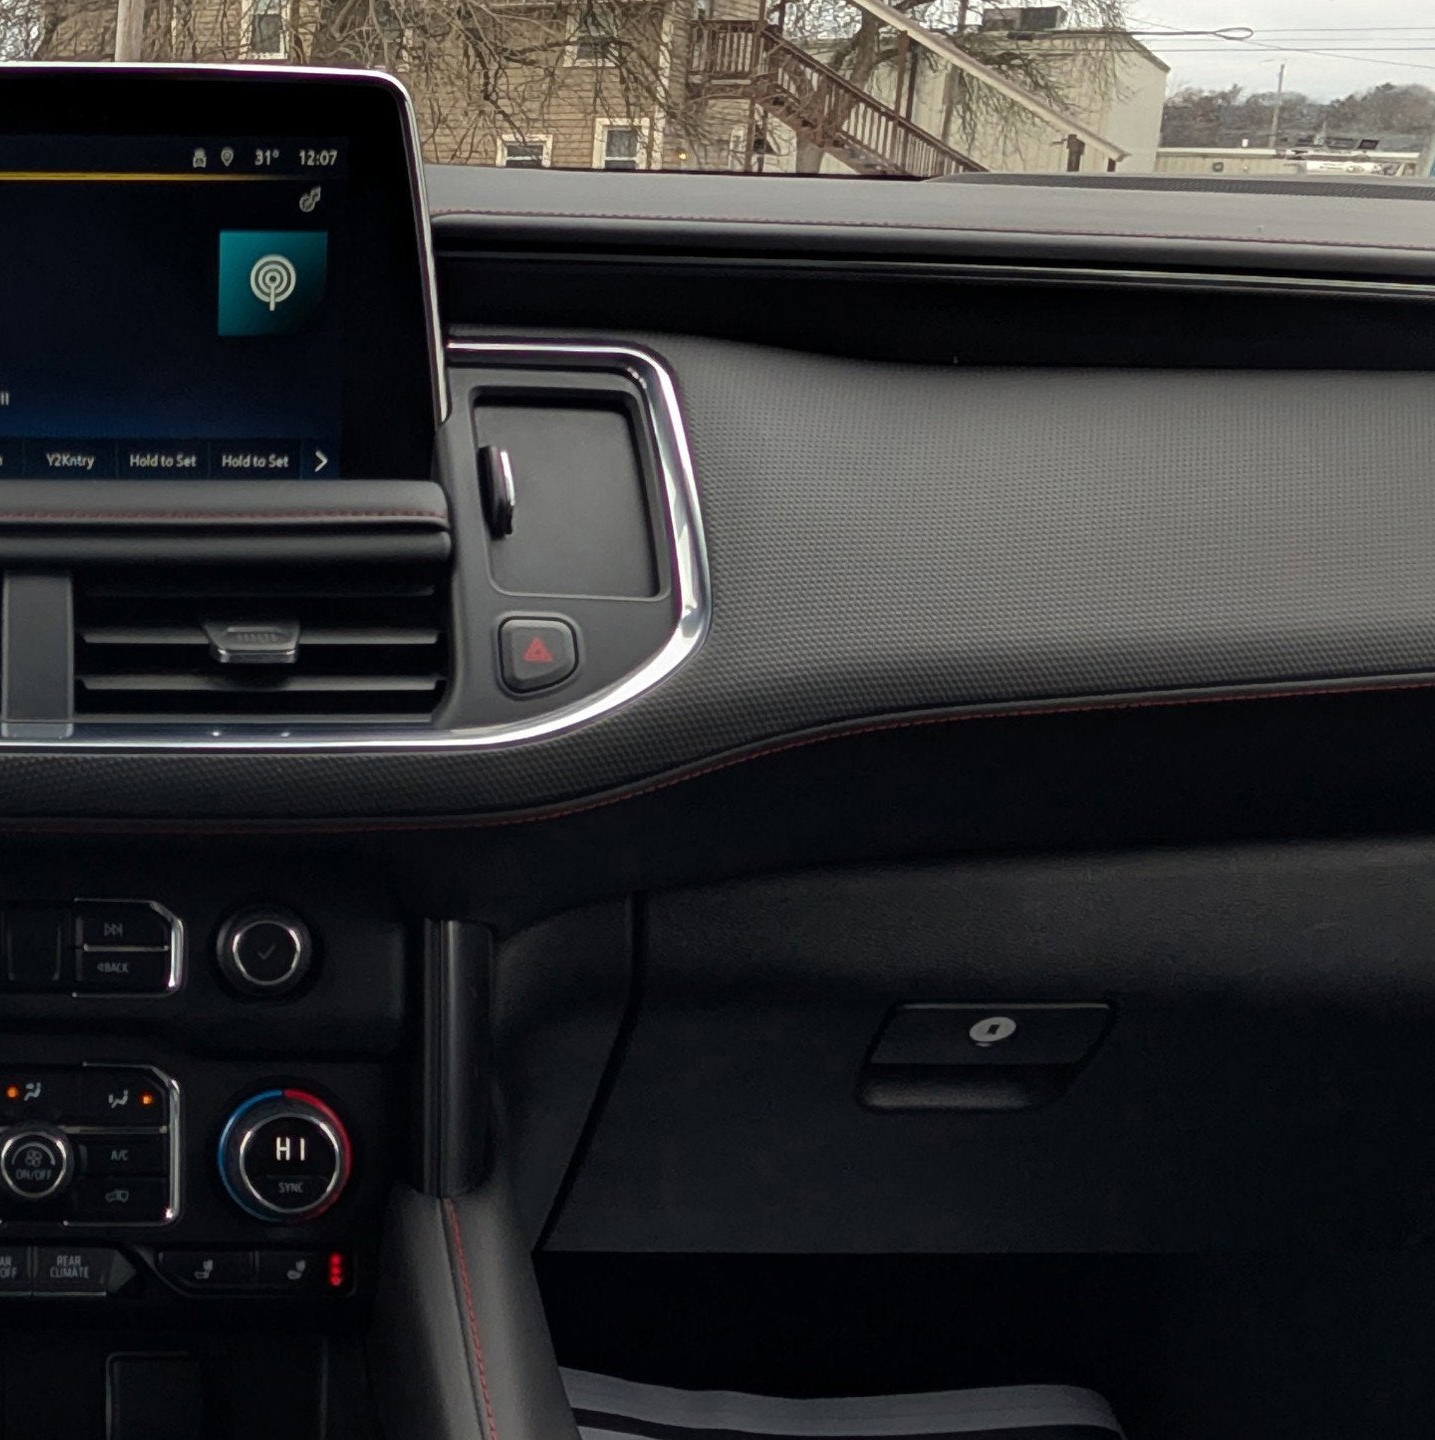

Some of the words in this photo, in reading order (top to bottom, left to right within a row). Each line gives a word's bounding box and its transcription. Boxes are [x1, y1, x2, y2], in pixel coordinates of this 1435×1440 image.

[299, 148, 338, 166] 12:07
[46, 452, 95, 470] Y2Kntry
[130, 452, 158, 468] Hold
[161, 454, 172, 468] to
[175, 453, 197, 468] Set
[222, 452, 250, 468] Hold
[253, 454, 264, 468] to
[267, 453, 290, 468] Set
[103, 962, 130, 973] BACK
[275, 1136, 306, 1161] HI
[109, 1149, 129, 1162] A/C
[15, 1168, 53, 1181] ON/OFF
[277, 1181, 305, 1194] SYNC
[56, 1255, 82, 1268] REAR
[50, 1266, 90, 1279] CLIMATE
